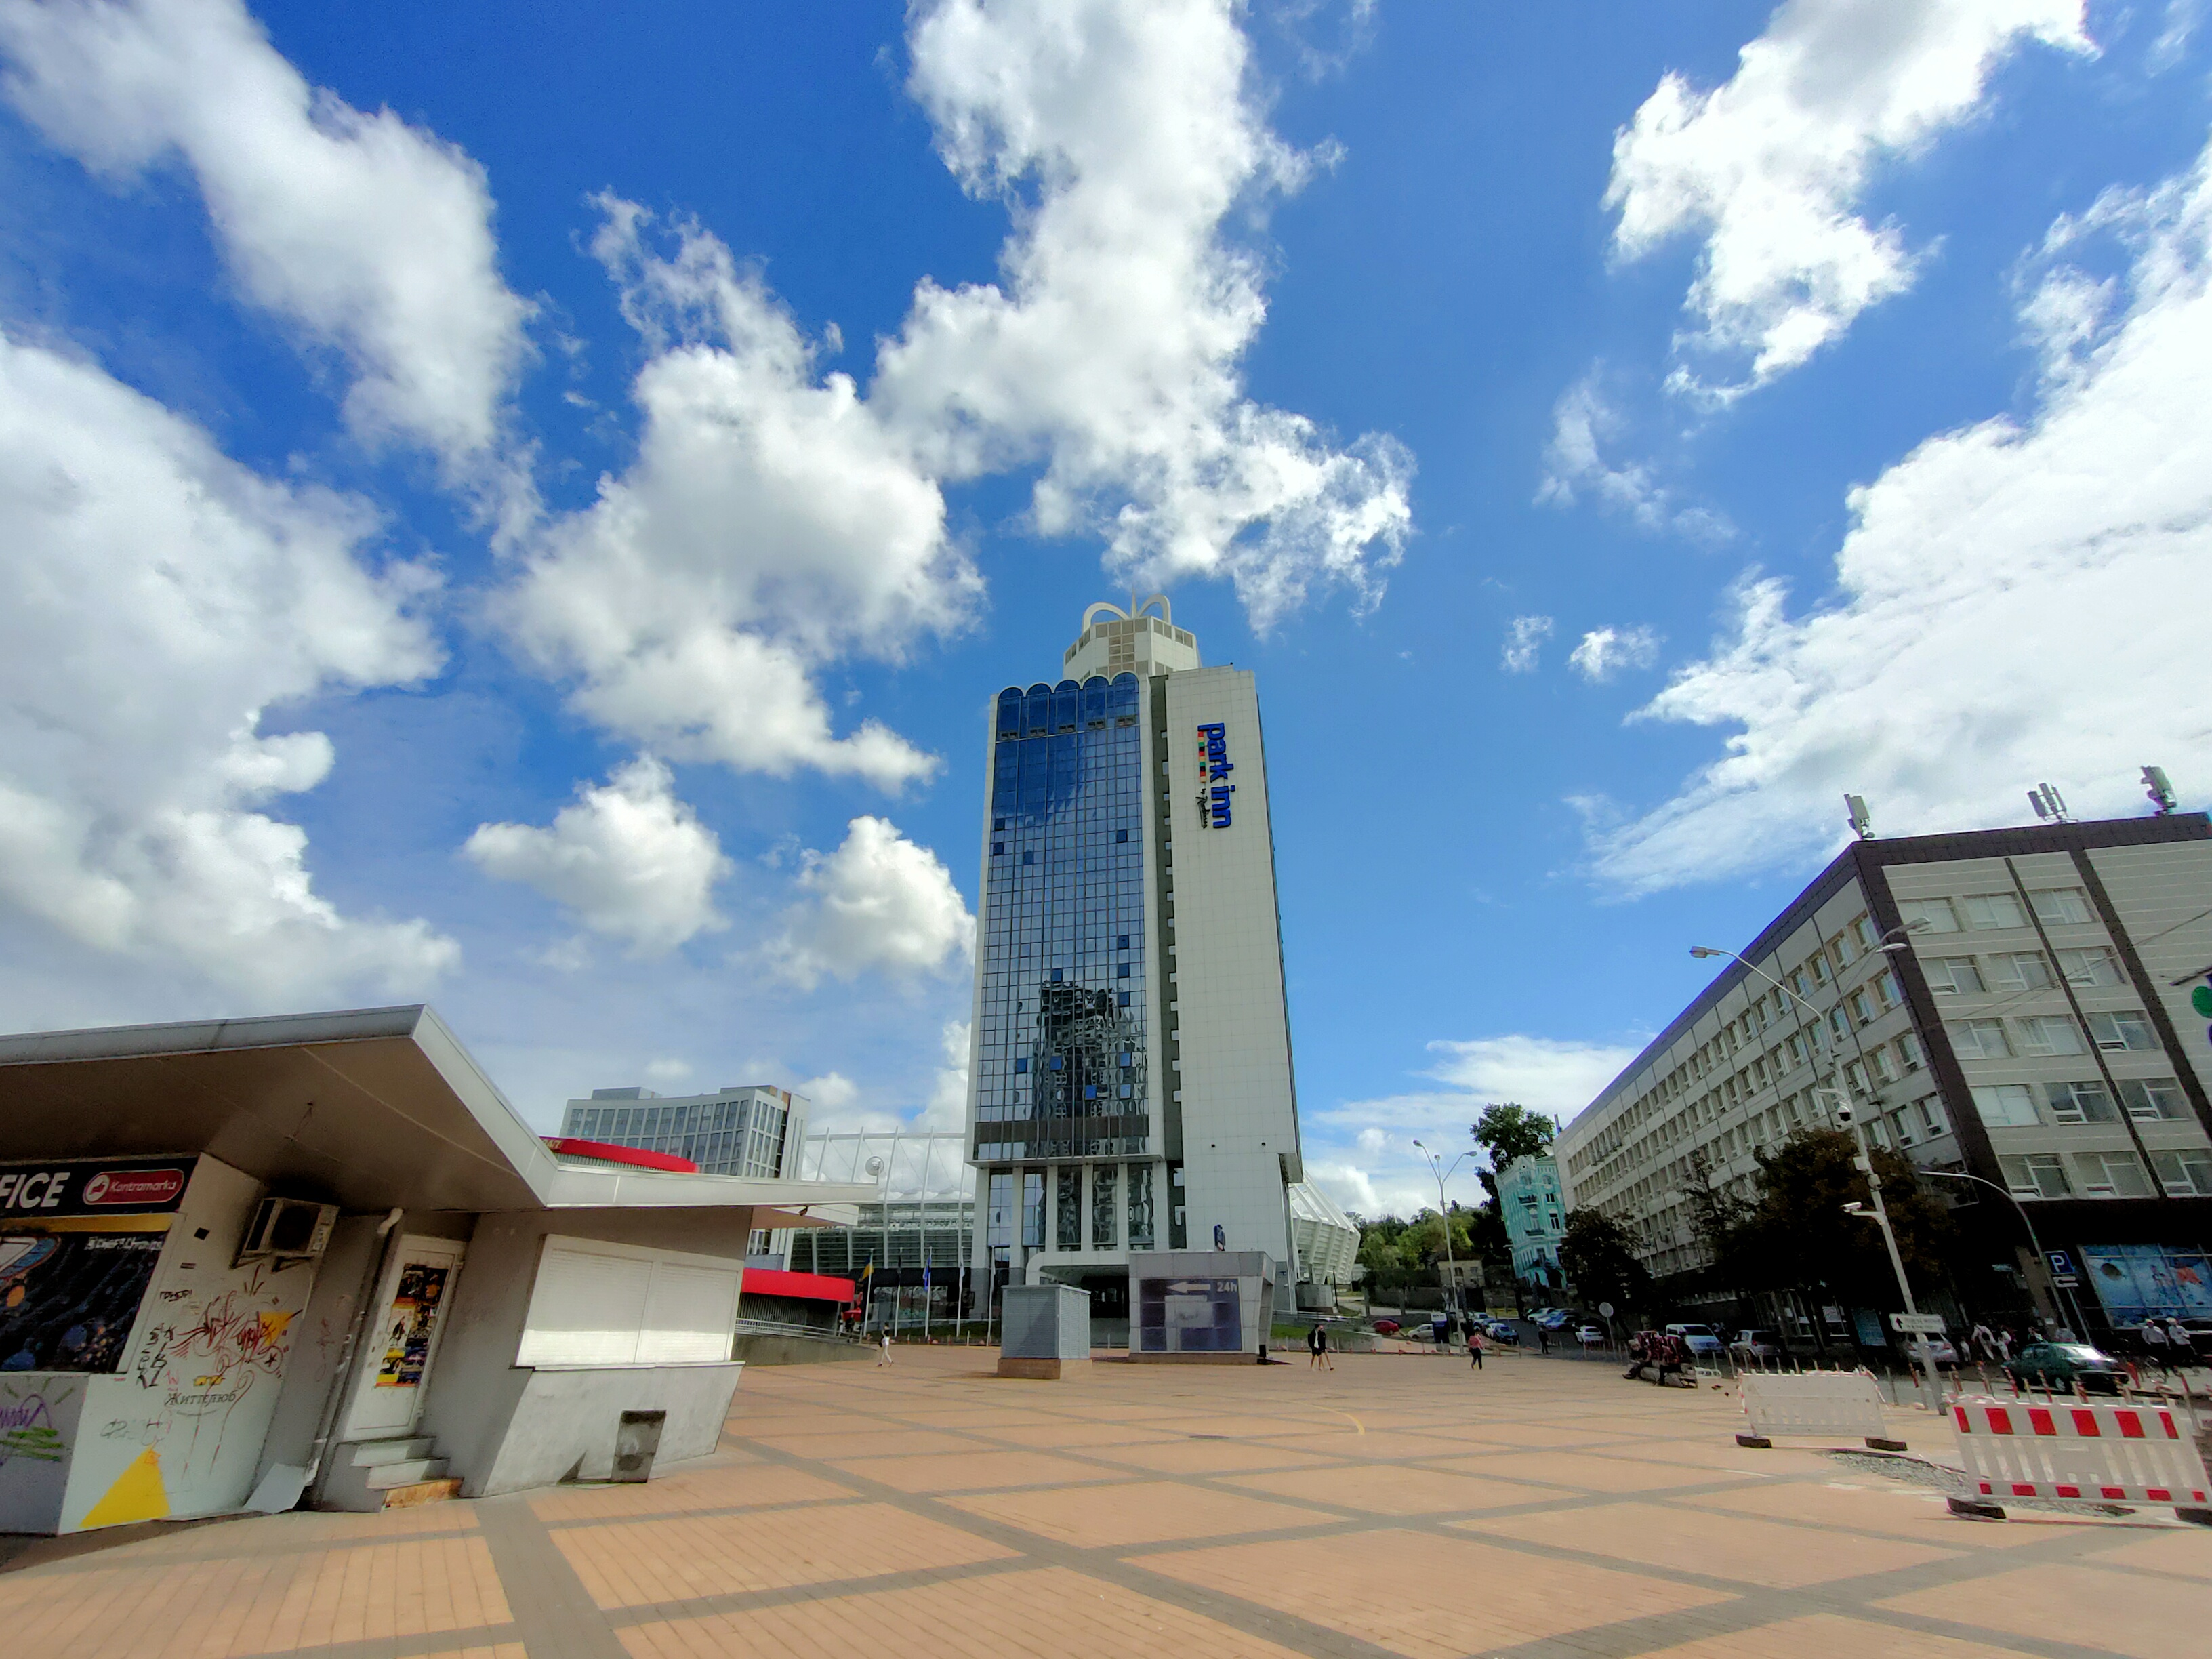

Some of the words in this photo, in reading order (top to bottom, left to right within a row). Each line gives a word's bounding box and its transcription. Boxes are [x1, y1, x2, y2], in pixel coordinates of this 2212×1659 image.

[1197, 722, 1234, 783] park
[1211, 785, 1236, 829] inn
[109, 1179, 177, 1192] Kontramarka
[2051, 1255, 2066, 1272] P
[1216, 1282, 1238, 1292] 24h
[164, 1389, 239, 1407] Життелюб
